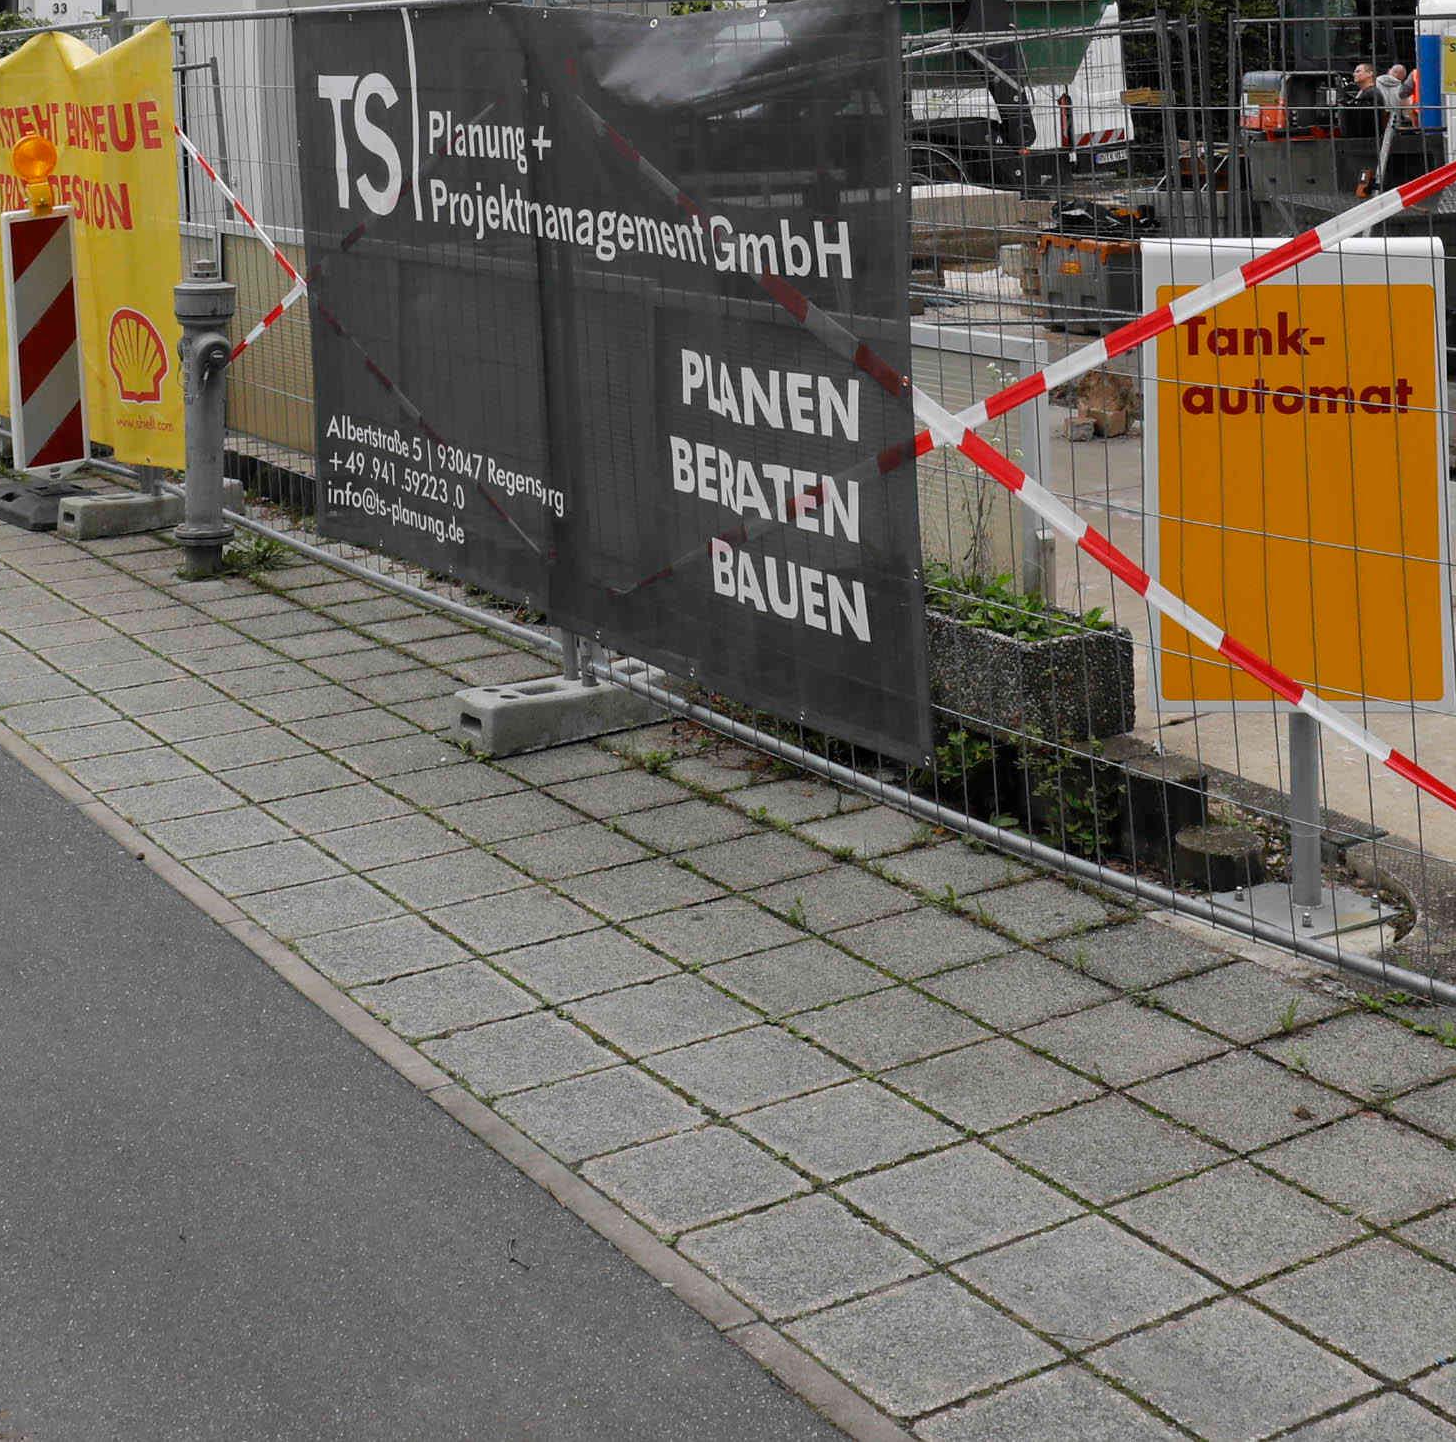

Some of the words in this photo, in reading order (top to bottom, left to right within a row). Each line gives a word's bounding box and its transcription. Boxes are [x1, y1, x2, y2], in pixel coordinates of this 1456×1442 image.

[52, 2, 67, 14] 33
[317, 72, 402, 216] TS
[429, 111, 528, 174] Planung
[532, 125, 552, 161] +
[711, 215, 853, 279] GmbH
[1182, 312, 1326, 356] Tank-
[681, 348, 860, 443] PLANEN
[1182, 378, 1412, 415] automat
[326, 415, 409, 457] Albertstraße
[412, 438, 422, 462] 5
[437, 444, 483, 480] 93047
[329, 451, 365, 476] +49
[328, 480, 465, 545] info@ts-planung.de
[669, 434, 860, 544] BERATEN
[711, 536, 873, 643] BAUEN
